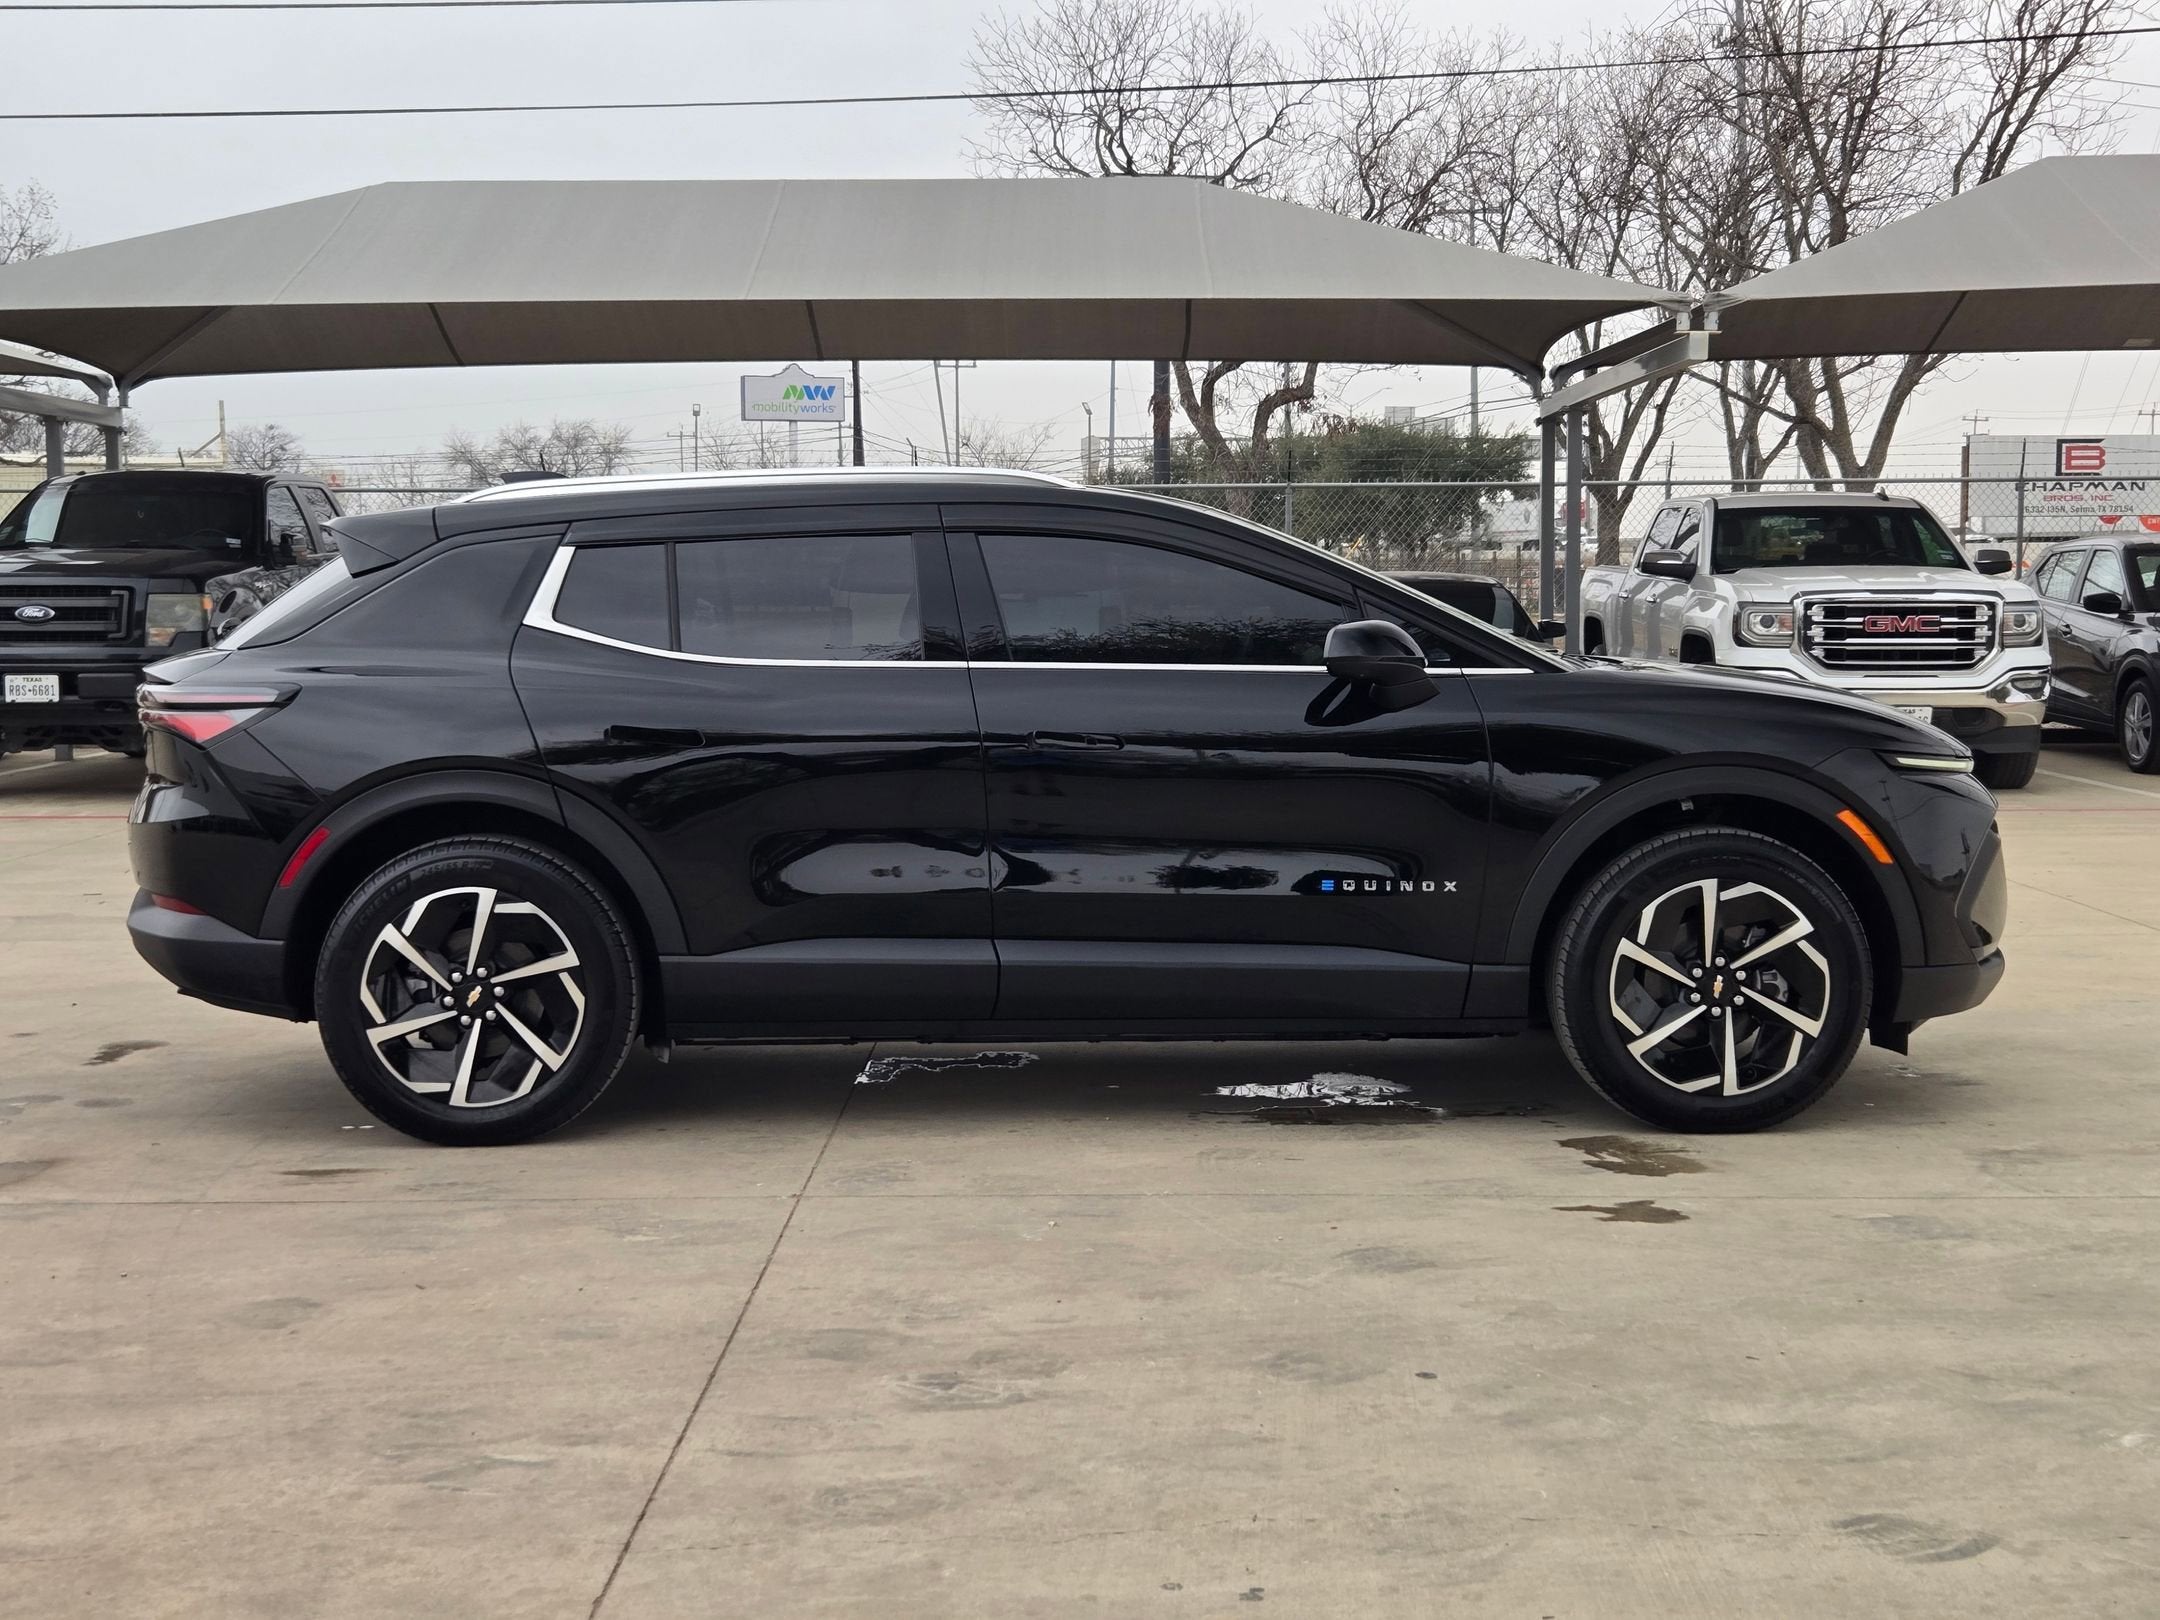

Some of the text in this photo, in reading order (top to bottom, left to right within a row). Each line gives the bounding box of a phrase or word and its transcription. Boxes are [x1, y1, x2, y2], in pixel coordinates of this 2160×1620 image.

[752, 401, 835, 414] mobilityworks
[2015, 481, 2146, 492] CHAPMAN
[2109, 504, 2134, 513] 78154
[22, 608, 46, 617] Ford
[1864, 615, 1940, 632] GMC
[1321, 879, 1457, 892] EQUINOX
